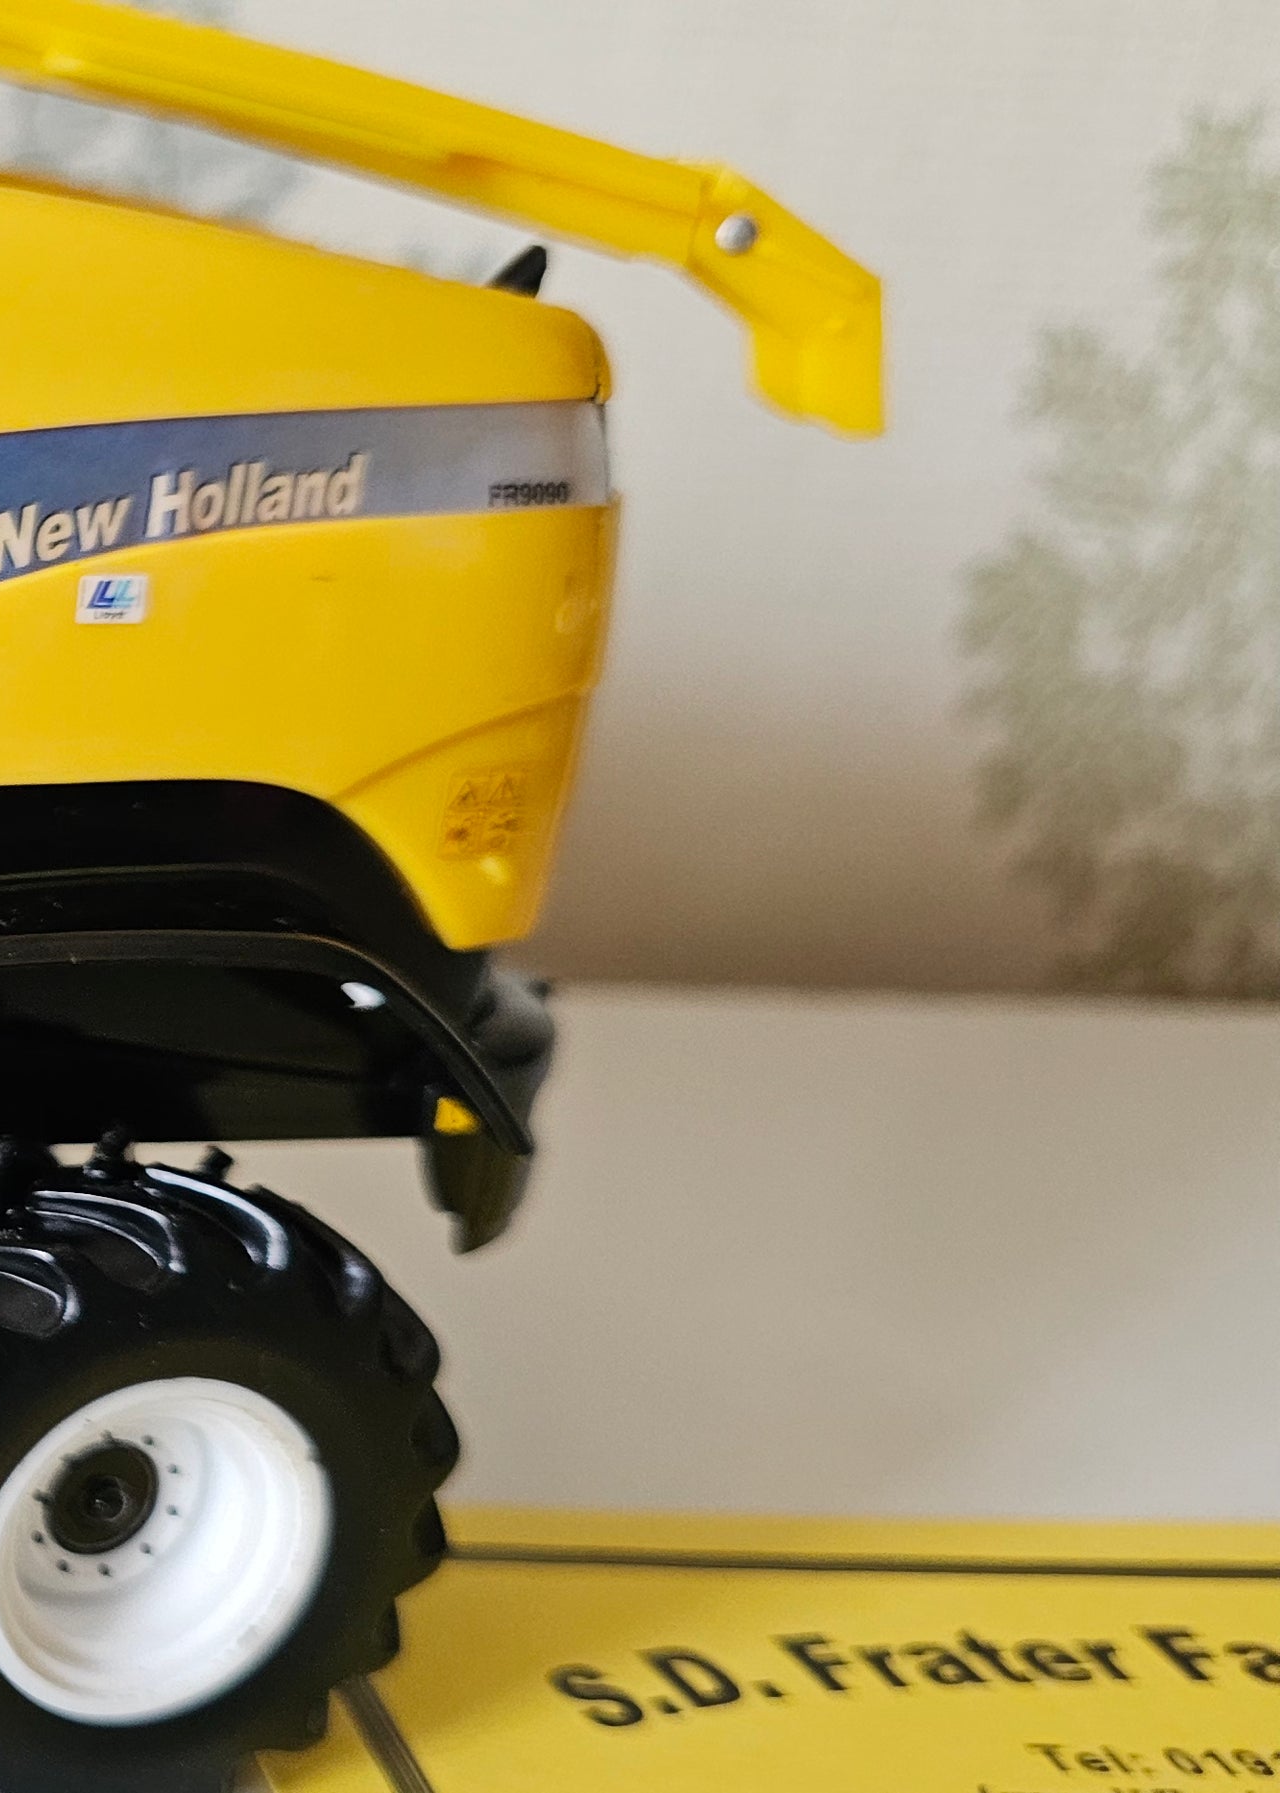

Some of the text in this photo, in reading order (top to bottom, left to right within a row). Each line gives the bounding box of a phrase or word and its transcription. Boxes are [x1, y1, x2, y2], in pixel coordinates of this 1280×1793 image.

[144, 450, 370, 539] Holland
[547, 1645, 785, 1727] S.D.
[772, 1626, 1132, 1692] Frater
[1023, 1742, 1280, 1777] Tel: 019
